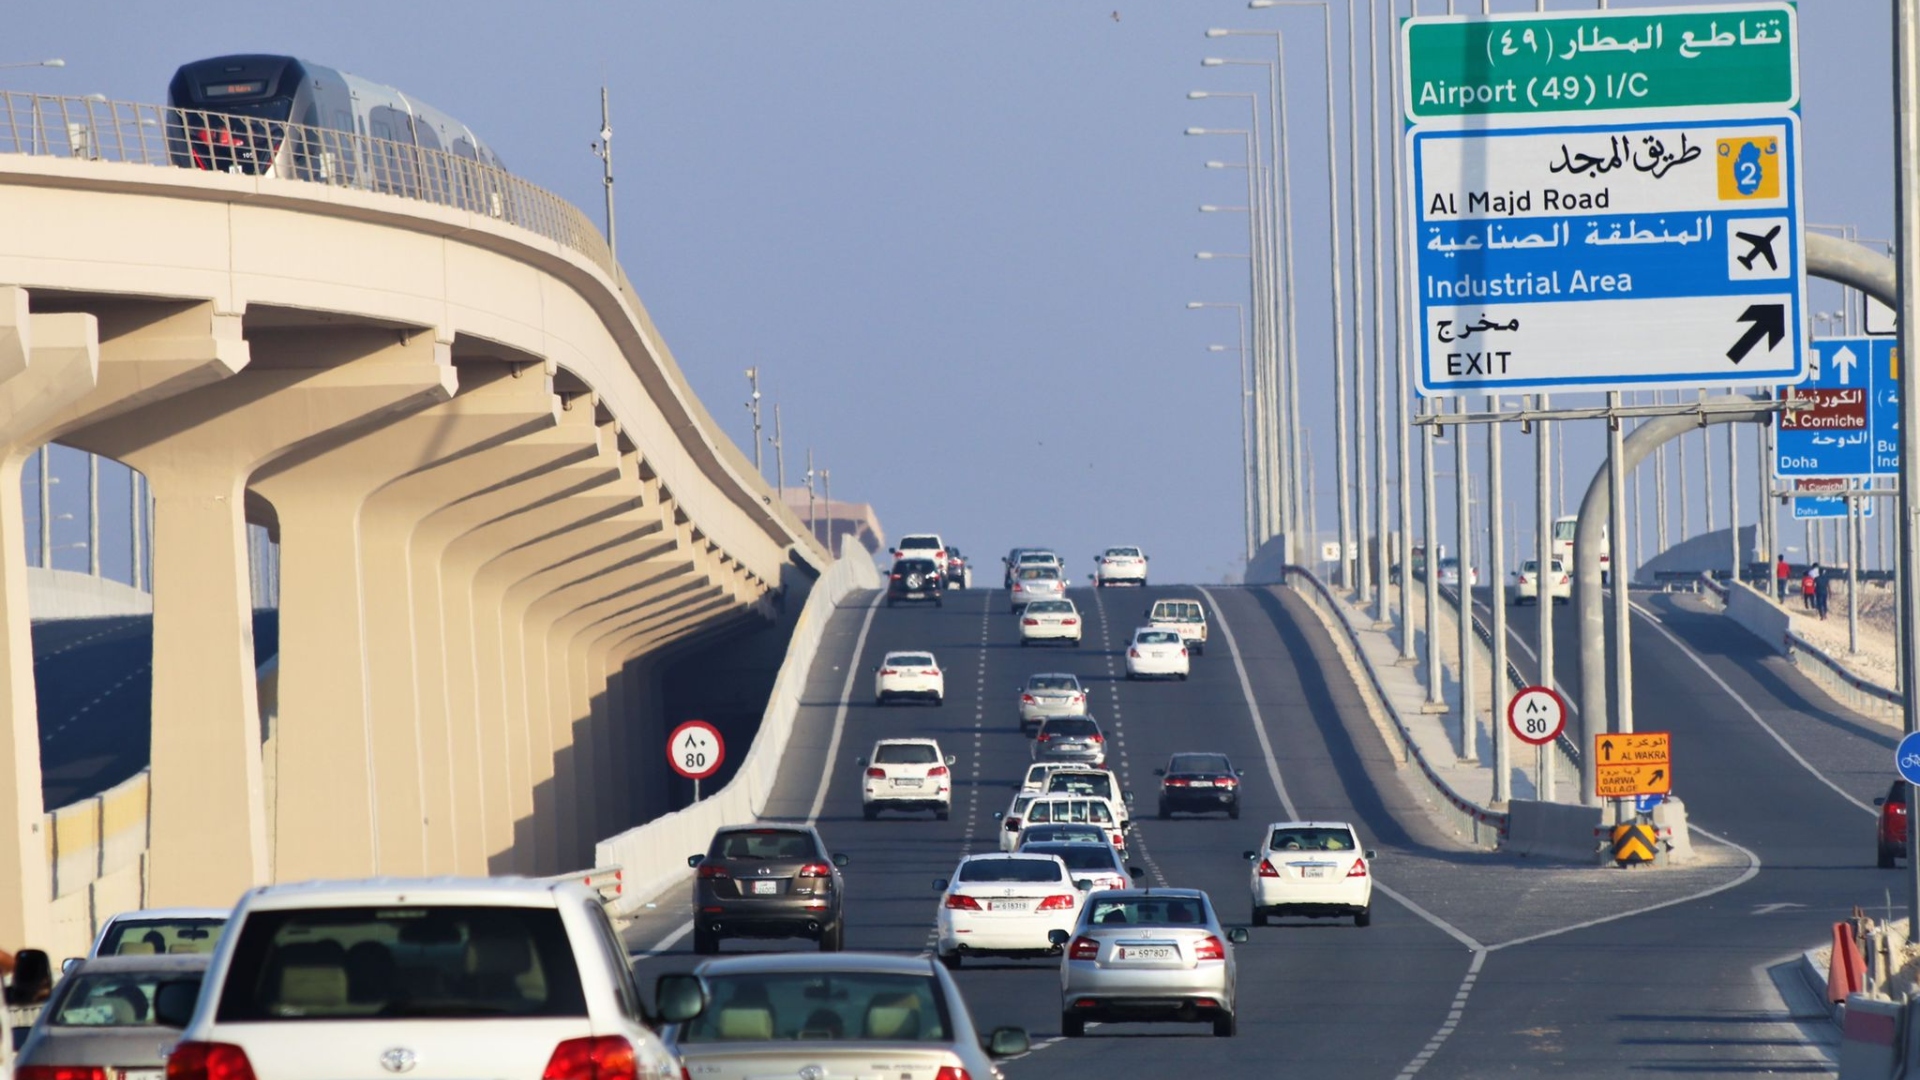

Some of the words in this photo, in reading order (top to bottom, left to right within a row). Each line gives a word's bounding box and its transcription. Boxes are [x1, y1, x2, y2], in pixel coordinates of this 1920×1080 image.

[1559, 23, 1663, 61] المطار
[1679, 18, 1782, 58] تقاطع
[1419, 79, 1517, 107] Airport
[1527, 74, 1597, 108] (49)
[1607, 72, 1650, 98] I/C
[1549, 134, 1629, 179] المجد
[1633, 132, 1702, 179] طريق
[1718, 142, 1730, 158] Q
[1740, 161, 1757, 185] 2
[1429, 193, 1458, 215] Al
[1468, 190, 1531, 219] Majd
[1544, 188, 1610, 211] Road
[1426, 221, 1570, 258] الصناعية
[1584, 214, 1714, 247] المنطقة
[1427, 270, 1560, 299] Industrial
[1569, 269, 1633, 294] Area
[1436, 313, 1520, 343] مخرج
[1447, 351, 1512, 376] EXIT
[1801, 414, 1865, 428] Corniche
[1812, 430, 1868, 448] الدوحة
[1781, 456, 1818, 469] Doha
[1526, 698, 1547, 714] ٨٠
[1526, 718, 1546, 734] 80
[684, 734, 706, 748] ٨٠
[685, 753, 705, 767] 80
[1621, 751, 1632, 760] AL
[1634, 750, 1667, 760] WAKRA
